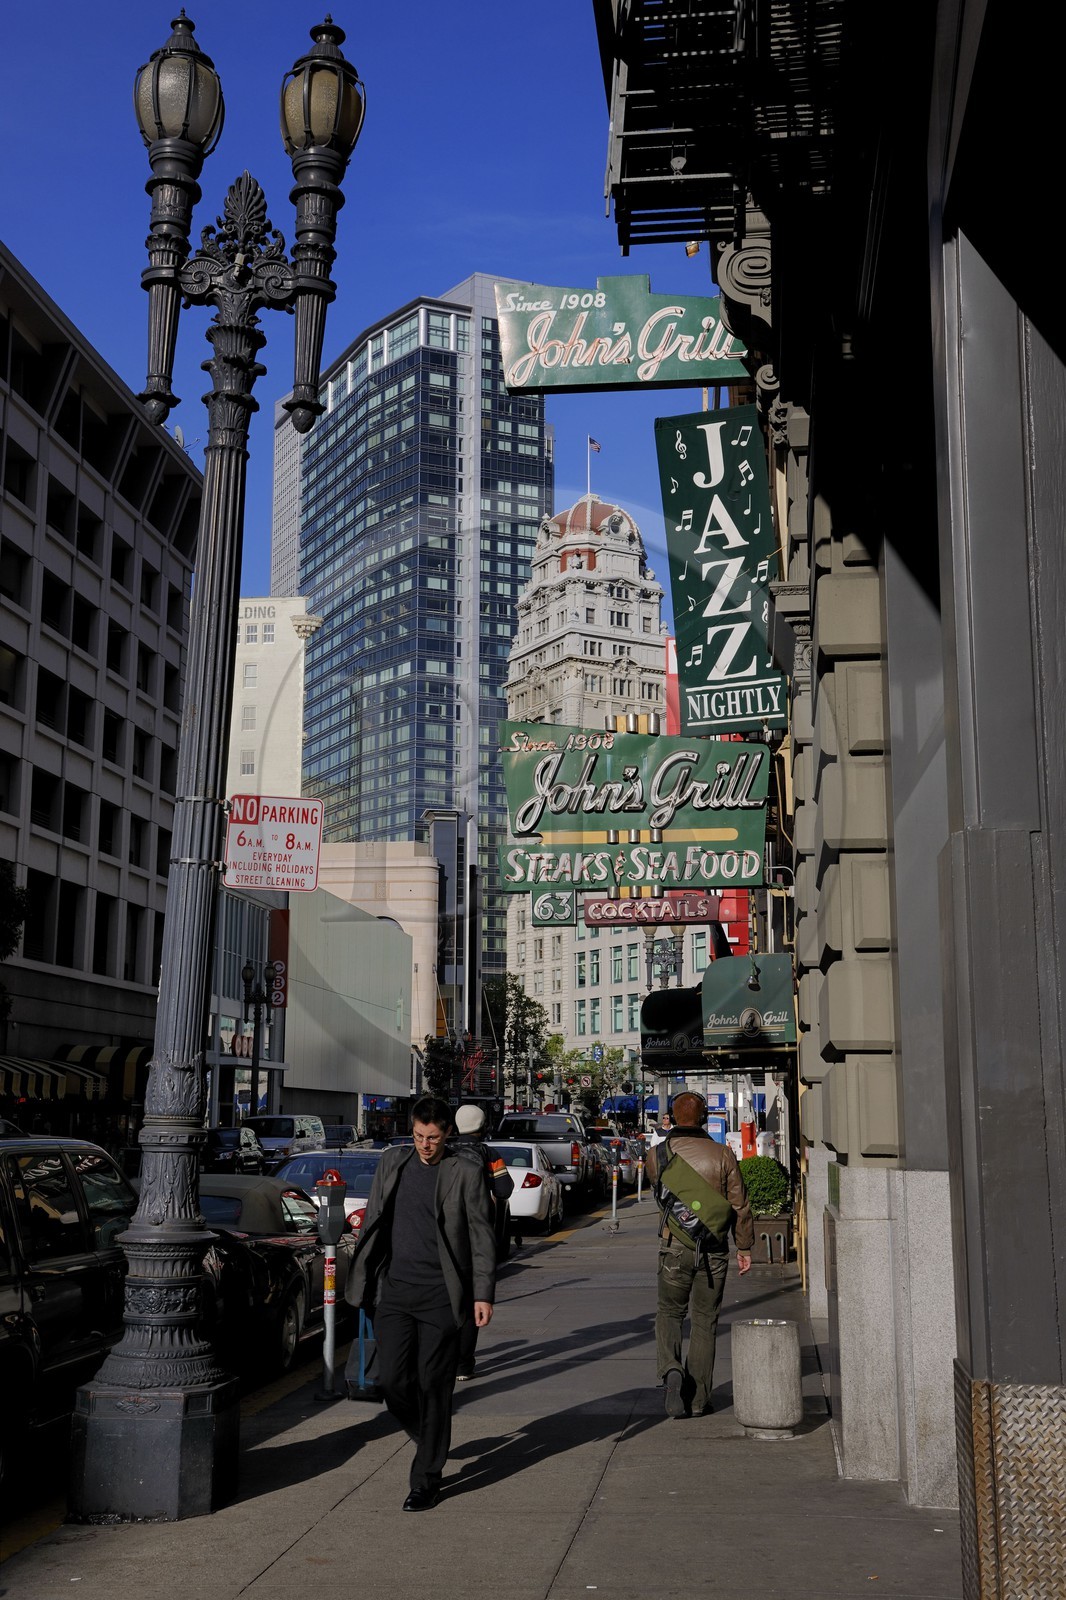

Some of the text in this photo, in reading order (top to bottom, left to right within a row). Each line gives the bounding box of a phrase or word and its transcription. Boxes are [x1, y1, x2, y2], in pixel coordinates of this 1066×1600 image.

[500, 293, 606, 312] Since 1908
[508, 306, 748, 386] John's Grill
[692, 421, 757, 681] JAZZ
[239, 606, 276, 619] DING
[687, 685, 781, 720] NIGHTLY
[499, 732, 615, 752] Since 1908
[515, 751, 768, 832] John's Grill
[233, 798, 318, 825] NO PARKING
[252, 851, 293, 863] EVERYDAY
[505, 849, 609, 884] STEAKS
[228, 861, 314, 875] INCLUDING HOLIDAYS
[235, 874, 306, 888] STREET CLEANING
[533, 894, 572, 921] 63
[587, 899, 711, 922] COCKTAILS
[707, 1010, 789, 1029] John's Grill
[645, 1037, 671, 1050] John's
